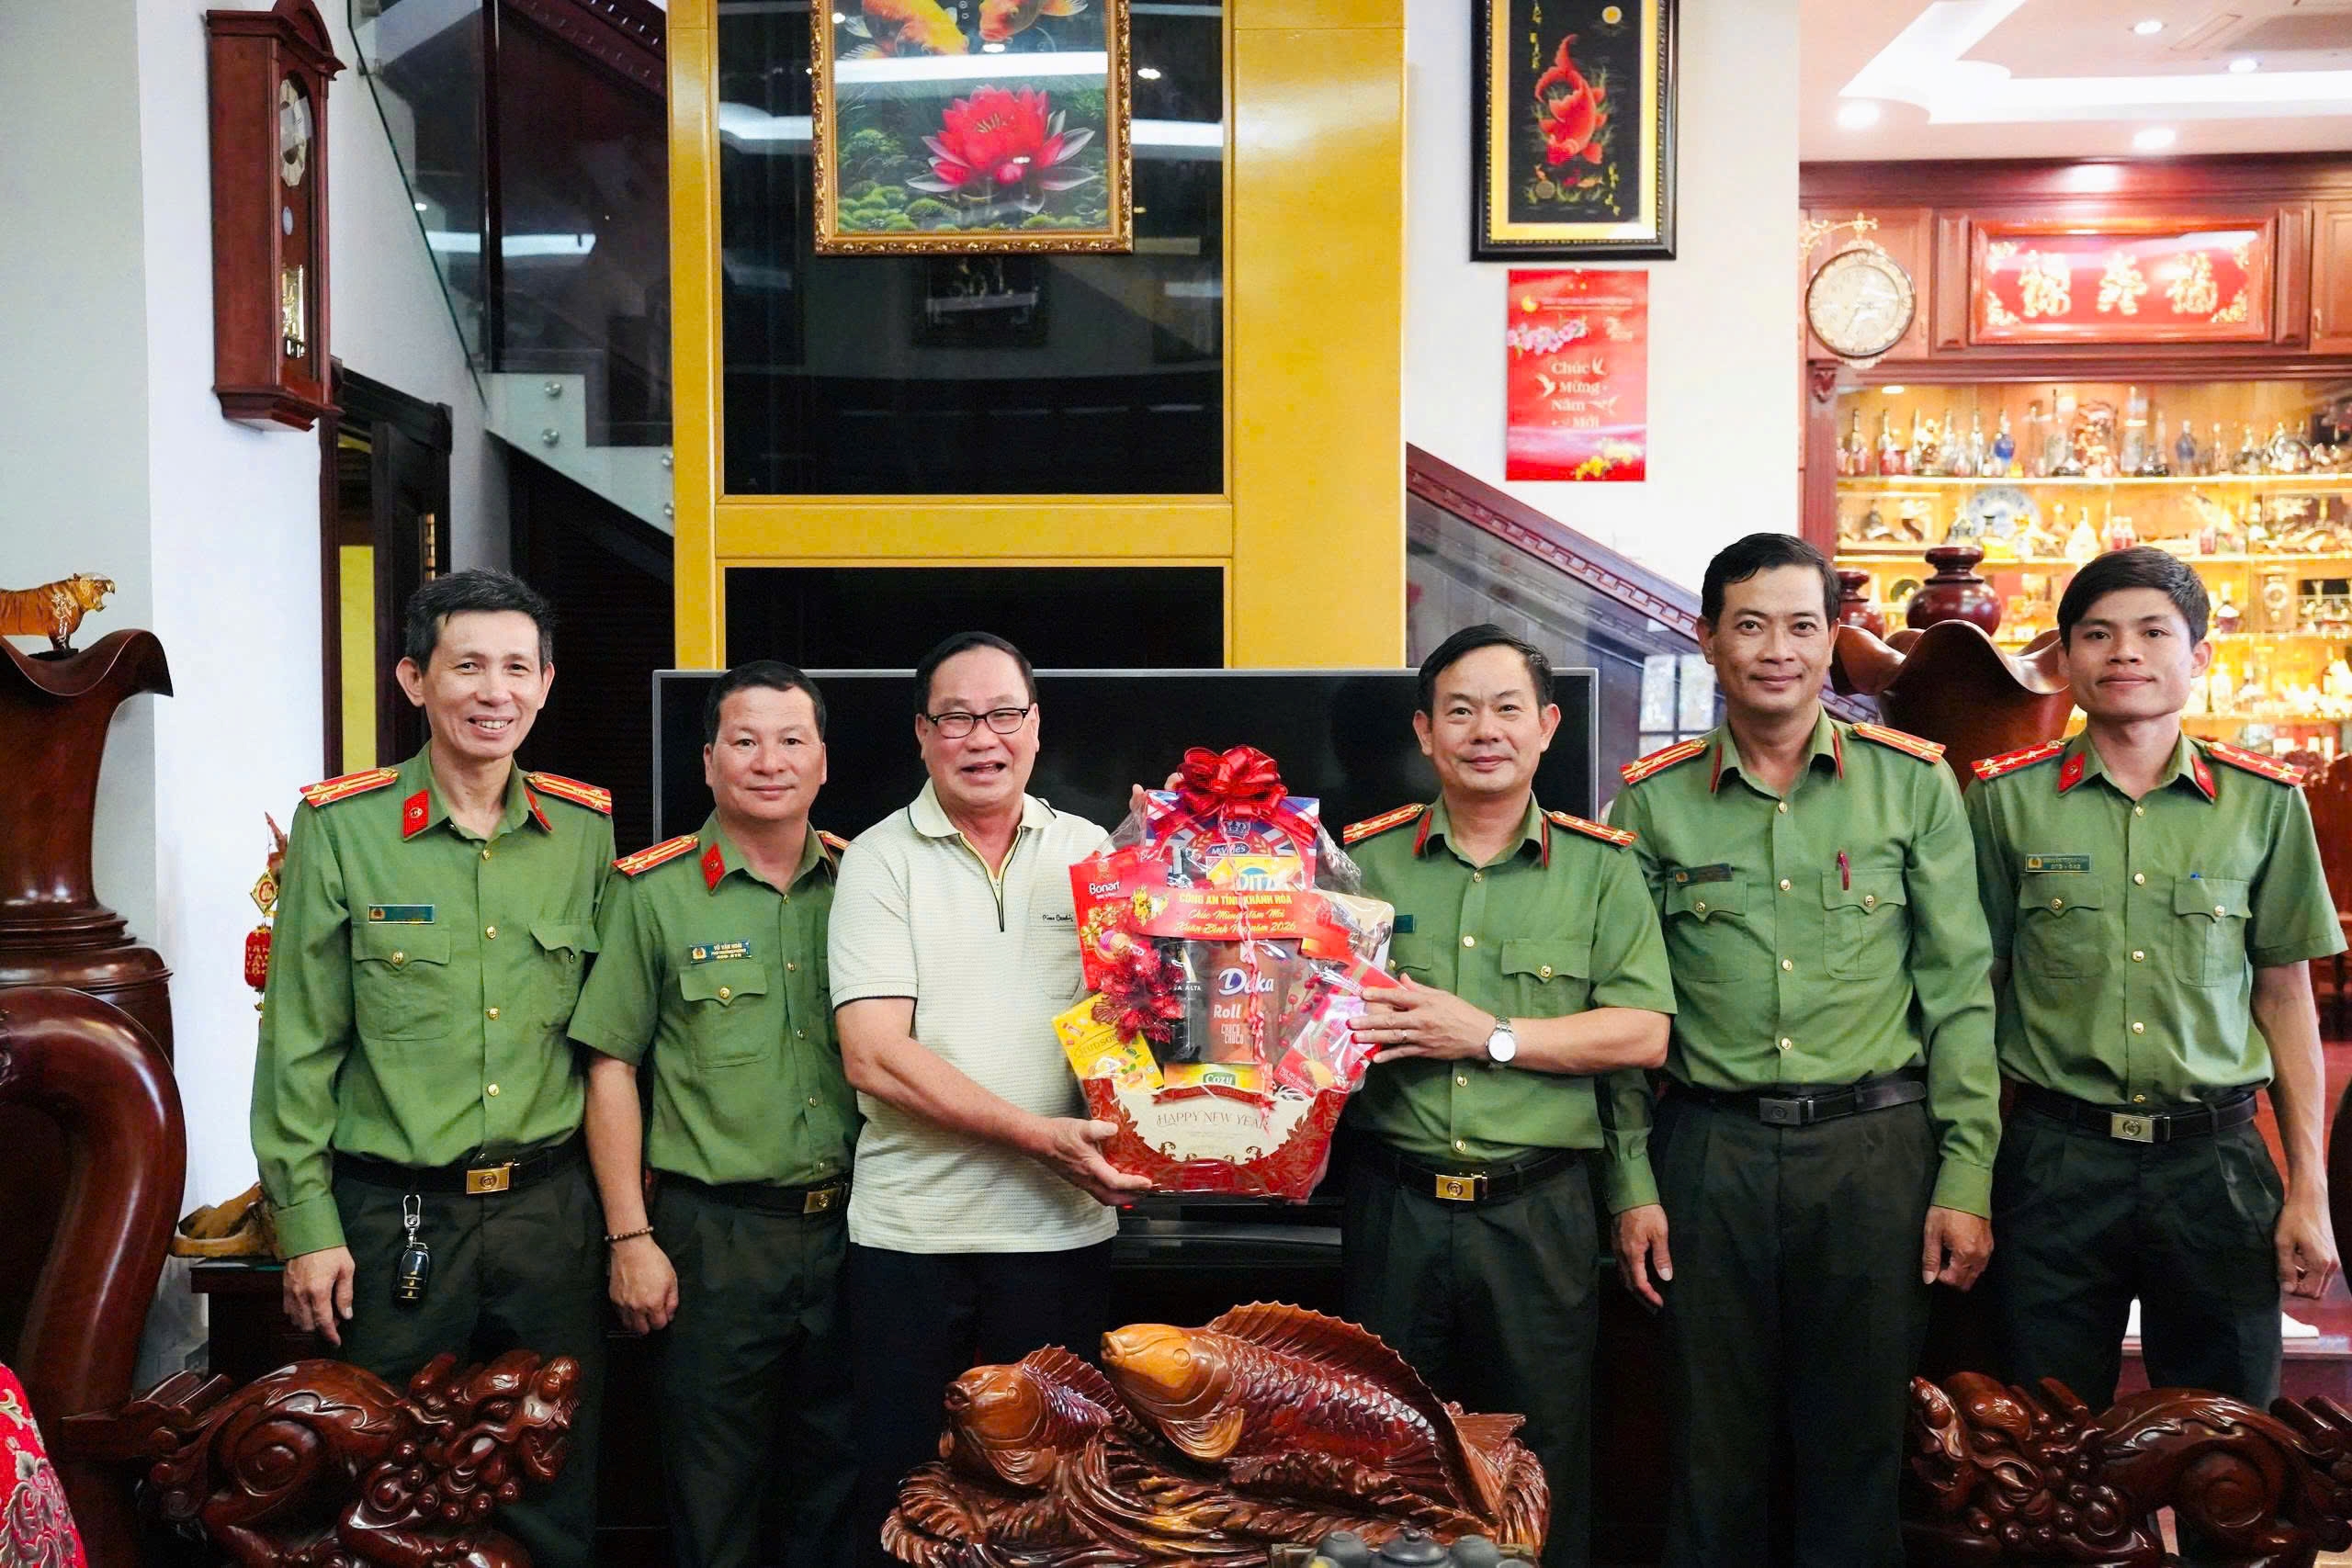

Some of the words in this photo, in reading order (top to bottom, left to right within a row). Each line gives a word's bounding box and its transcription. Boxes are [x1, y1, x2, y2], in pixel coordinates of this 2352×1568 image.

[1551, 359, 1590, 375] Chúc
[1559, 380, 1600, 396] Mừng
[1551, 398, 1585, 412] Năm
[1179, 893, 1204, 905] CÔNG
[1205, 895, 1219, 905] AN
[1274, 894, 1293, 905] HÒA
[1271, 921, 1296, 932] 2026
[1213, 1003, 1241, 1019] Roll
[1204, 1074, 1234, 1085] Cozy
[1156, 1111, 1198, 1128] HAPPY
[1202, 1111, 1231, 1124] NEW
